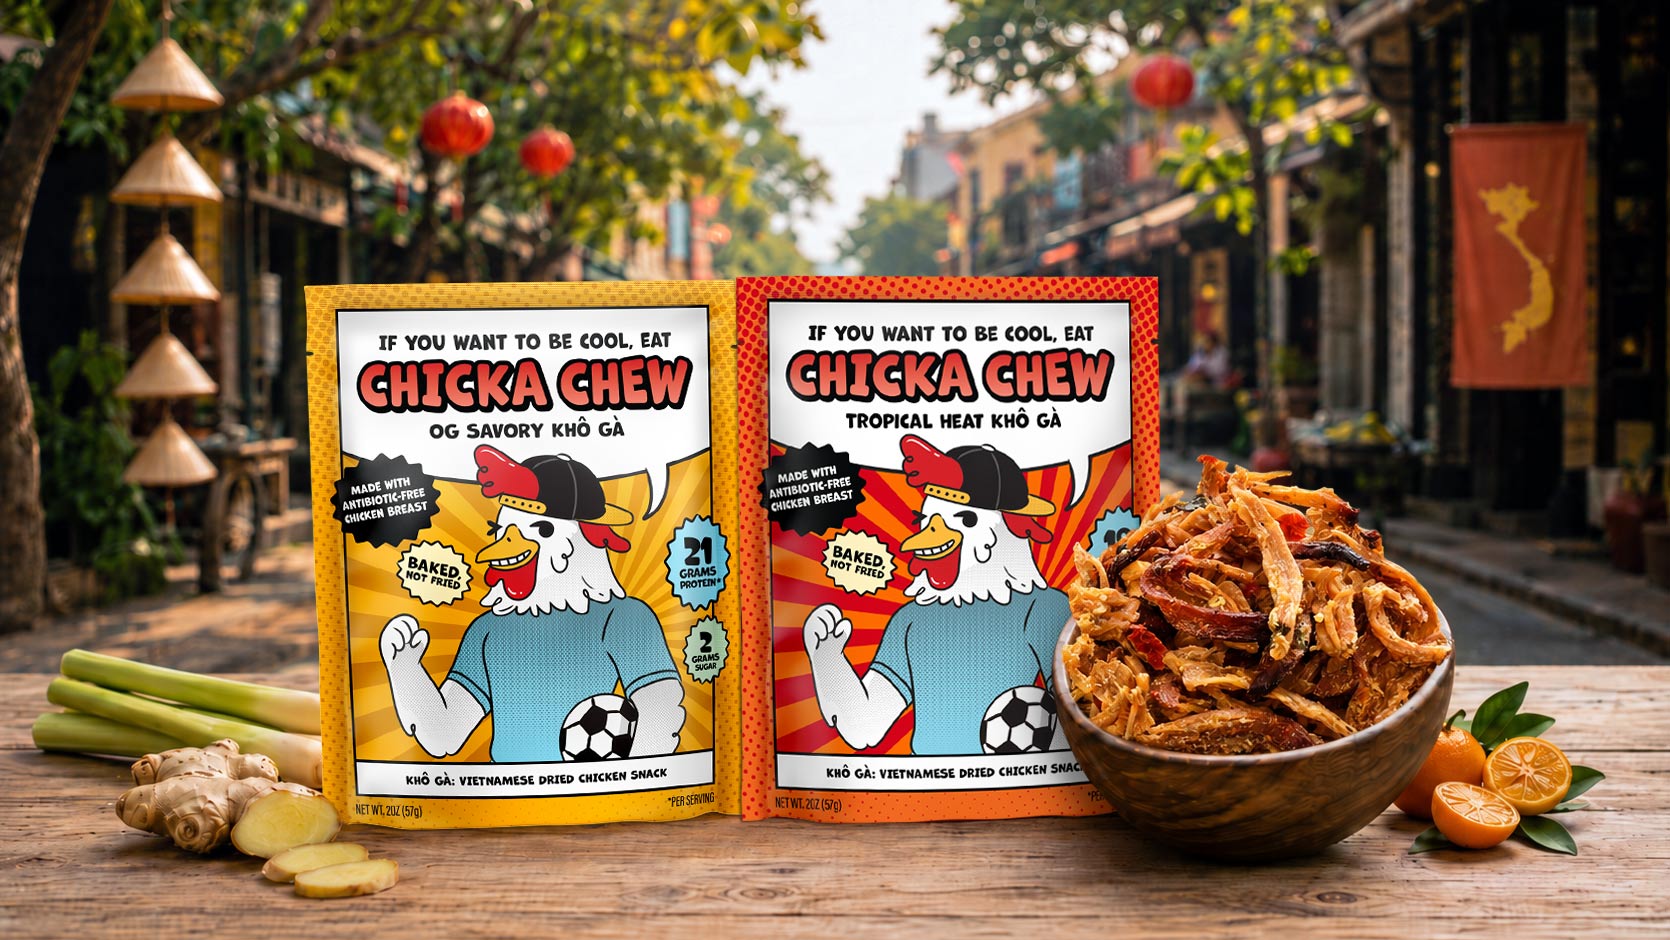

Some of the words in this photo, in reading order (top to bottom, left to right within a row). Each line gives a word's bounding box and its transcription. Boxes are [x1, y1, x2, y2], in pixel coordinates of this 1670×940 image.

[378, 335, 397, 351] IF
[405, 335, 446, 351] YOU
[454, 334, 507, 351] WANT
[515, 334, 541, 350] TO
[549, 333, 573, 349] BE
[580, 333, 633, 351] COOL,
[641, 332, 671, 348] EAT
[808, 325, 827, 341] IF
[834, 325, 874, 341] YOU
[882, 325, 935, 341] WANT
[942, 326, 967, 341] TO
[975, 326, 998, 341] BE
[1005, 326, 1057, 343] COOL,
[1065, 326, 1094, 341] EAT
[357, 358, 553, 413] CHICKA
[557, 355, 693, 411] CHEW
[786, 349, 978, 401] CHICKA
[982, 348, 1115, 401] CHEW
[846, 413, 933, 428] TROPICAL
[940, 413, 983, 428] HEAT
[991, 407, 1029, 428] KHÔ
[1037, 408, 1061, 428] GÀ
[429, 424, 459, 439] OG
[467, 423, 544, 438] SAVORY
[552, 417, 591, 437] KHÔ
[599, 416, 624, 437] GÀ
[778, 471, 808, 483] MADE
[811, 465, 837, 477] WITH
[351, 482, 381, 495] MADE
[384, 477, 411, 490] WITH
[769, 477, 851, 499] ANTIBIOTIC-FREE
[343, 488, 425, 511] ANTIBIOTIC-FREE
[771, 497, 810, 511] CHICKEN
[814, 490, 853, 505] BREAST
[345, 509, 384, 523] CHICKEN
[388, 501, 427, 517] BREAST
[684, 537, 712, 565] 21
[833, 546, 885, 570] BAKED,
[408, 557, 462, 580] BAKED,
[680, 566, 716, 579] GRAMS
[831, 560, 851, 571] NOT
[855, 566, 885, 579] FRIED
[406, 571, 428, 582] NOT
[431, 576, 461, 590] FRIED
[700, 632, 712, 653] 2
[692, 653, 719, 663] GRAMS
[695, 663, 717, 671] SUGAR
[406, 772, 430, 785] KHÔ
[435, 772, 455, 786] GÀ:
[460, 776, 534, 786] VIETNAMESE
[539, 775, 574, 785] DRIED
[579, 772, 627, 783] CHICKEN
[631, 768, 668, 780] SNACK
[827, 764, 850, 778] KHÔ
[855, 765, 875, 778] GÀ:
[880, 768, 955, 779] VIETNAMESE
[959, 768, 995, 778] DRIED
[999, 765, 1047, 776] CHICKEN
[1051, 763, 1083, 773] SNAC
[686, 792, 715, 806] SERVING
[776, 797, 789, 808] NET
[791, 798, 804, 809] WT.
[822, 800, 842, 813] (57g)
[356, 804, 370, 815] NET
[371, 805, 385, 816] WT.
[402, 806, 422, 818] (57g)
